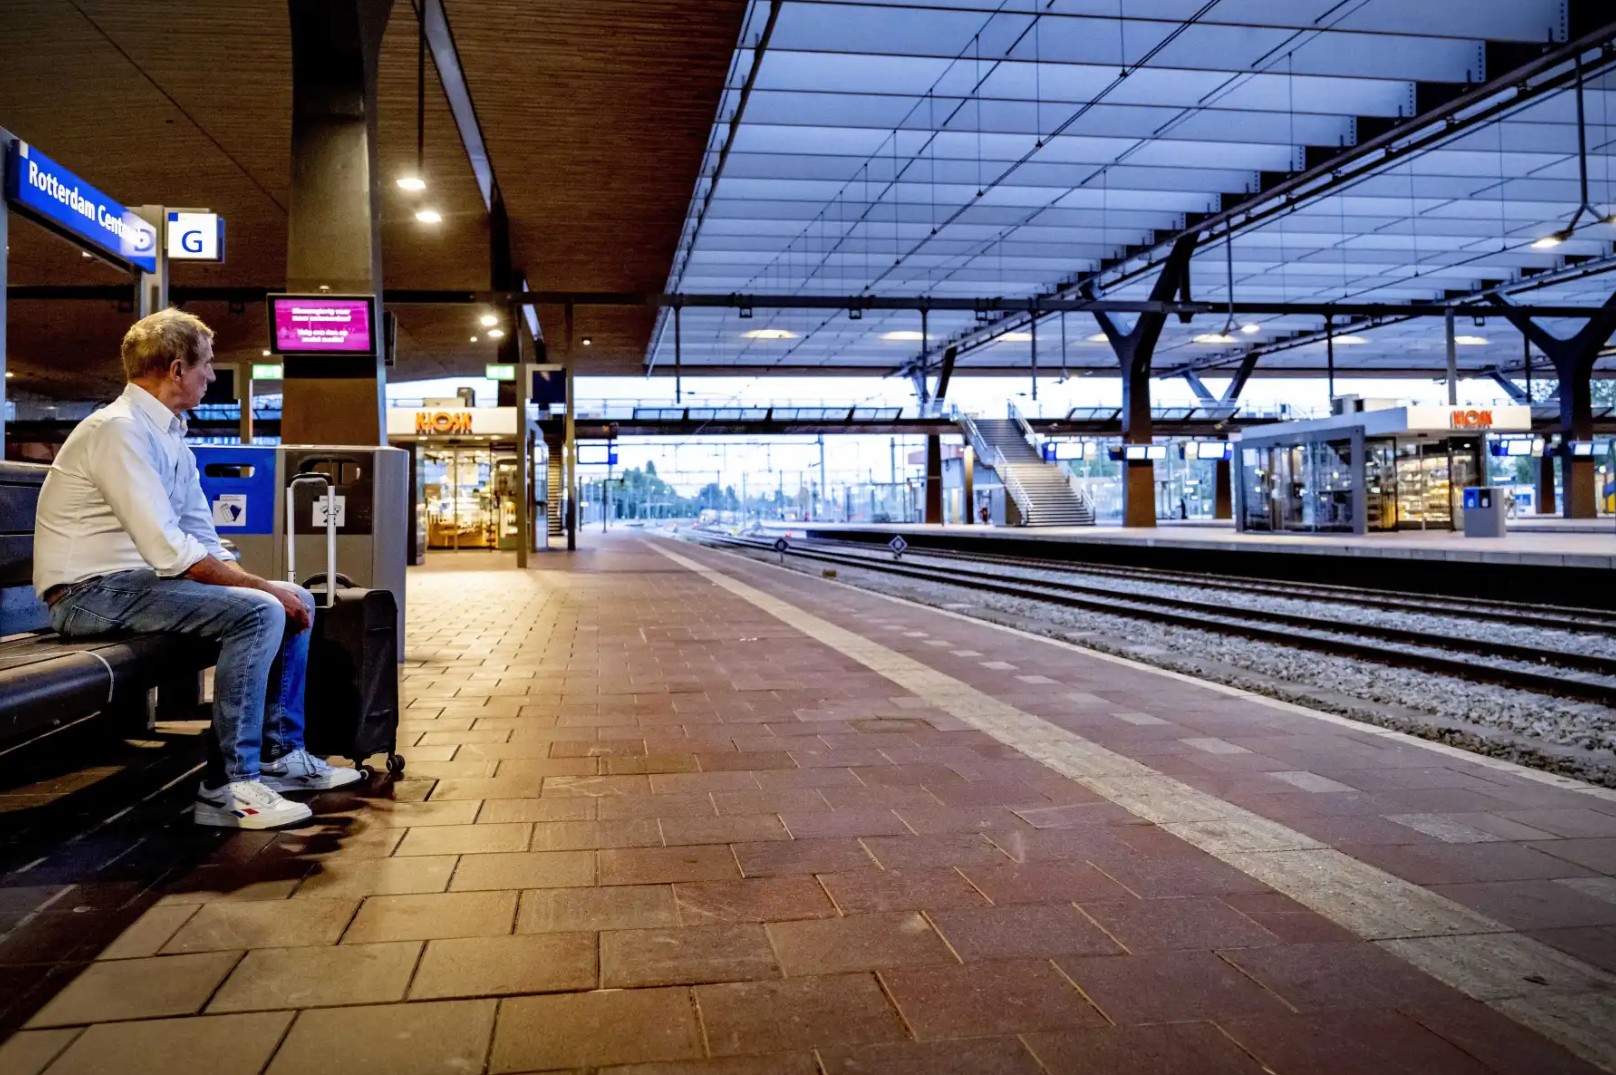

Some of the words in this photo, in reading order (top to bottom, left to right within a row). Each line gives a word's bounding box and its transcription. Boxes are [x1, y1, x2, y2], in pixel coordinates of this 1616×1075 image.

[28, 160, 95, 221] Rotterdam
[181, 230, 203, 253] G
[415, 411, 473, 433] KIOSK
